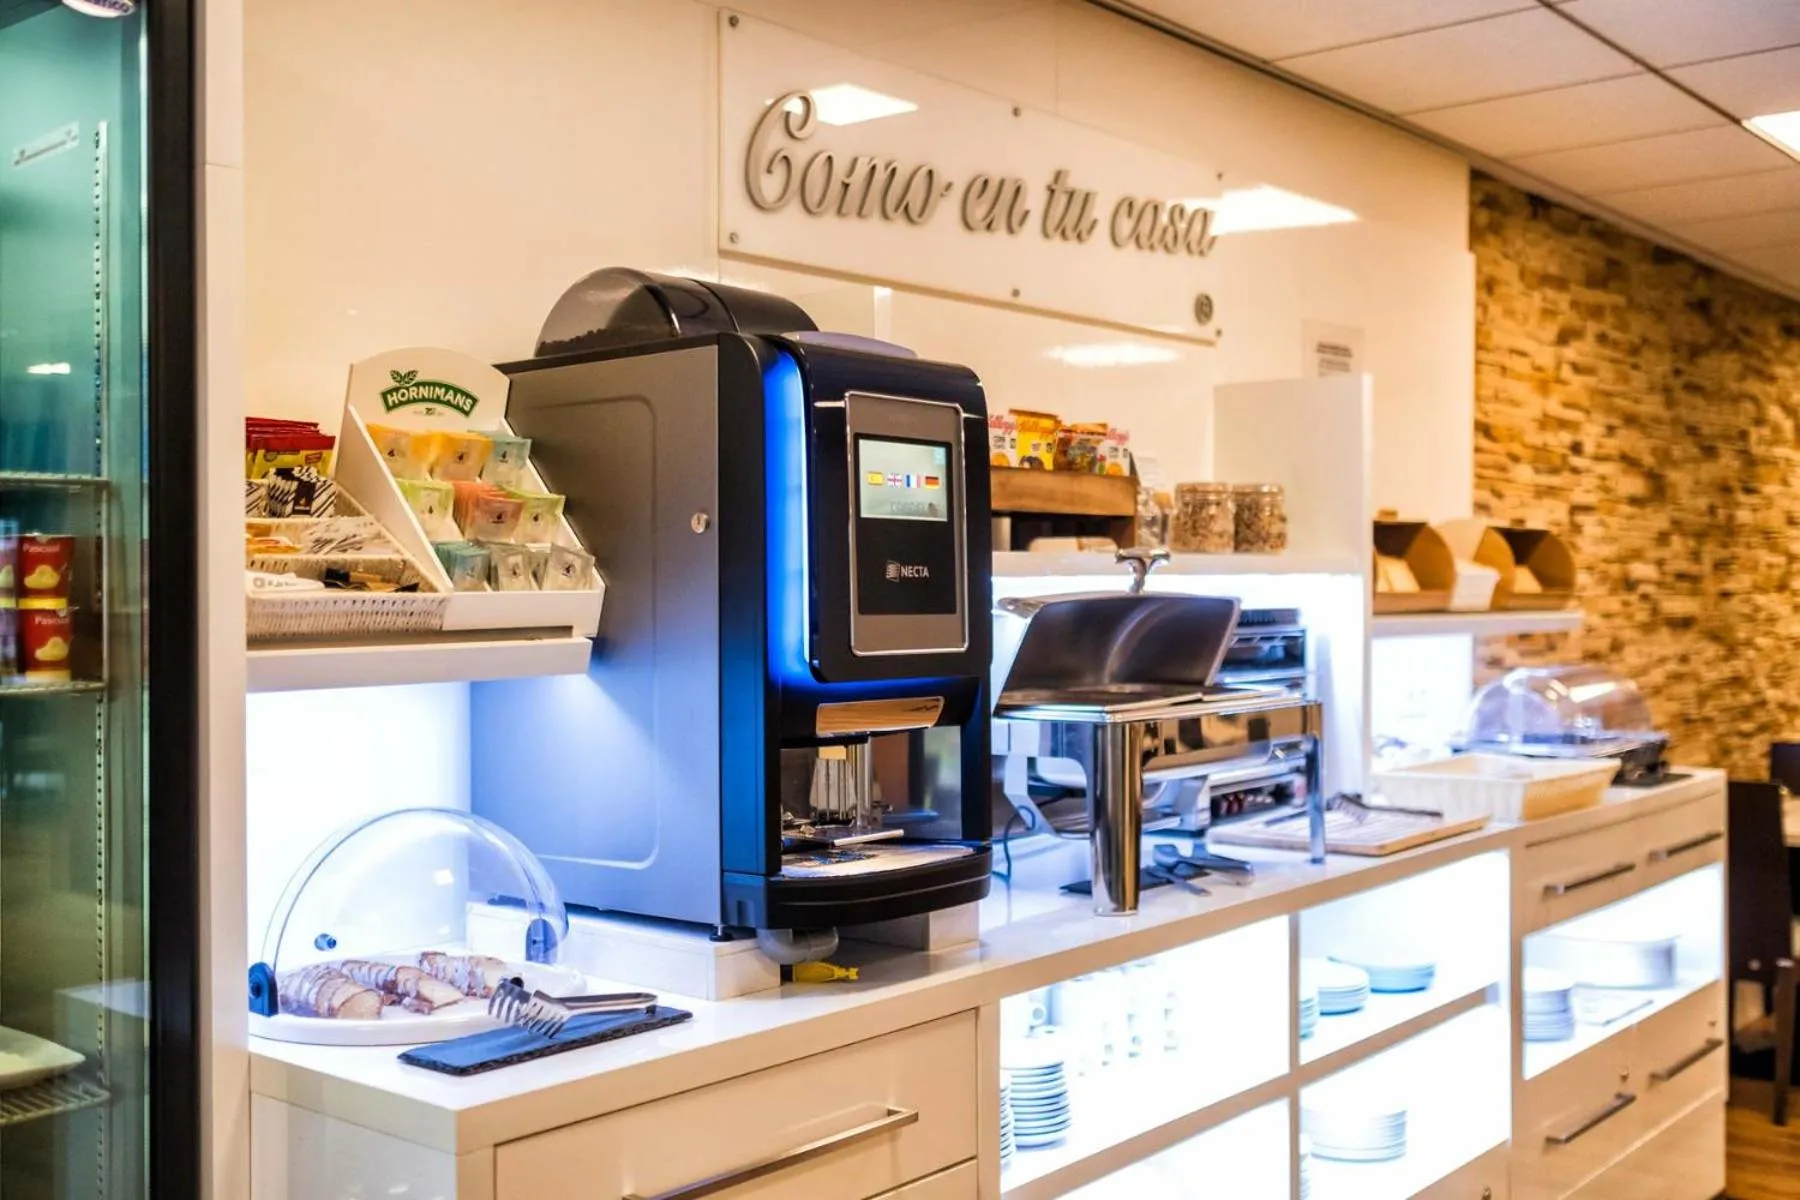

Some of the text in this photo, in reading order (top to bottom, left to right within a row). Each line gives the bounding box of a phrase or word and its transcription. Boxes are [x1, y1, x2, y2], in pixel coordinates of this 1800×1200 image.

[745, 90, 1219, 258] Como en tu casa
[386, 385, 474, 412] HORNIMANS
[900, 564, 930, 579] NECTA
